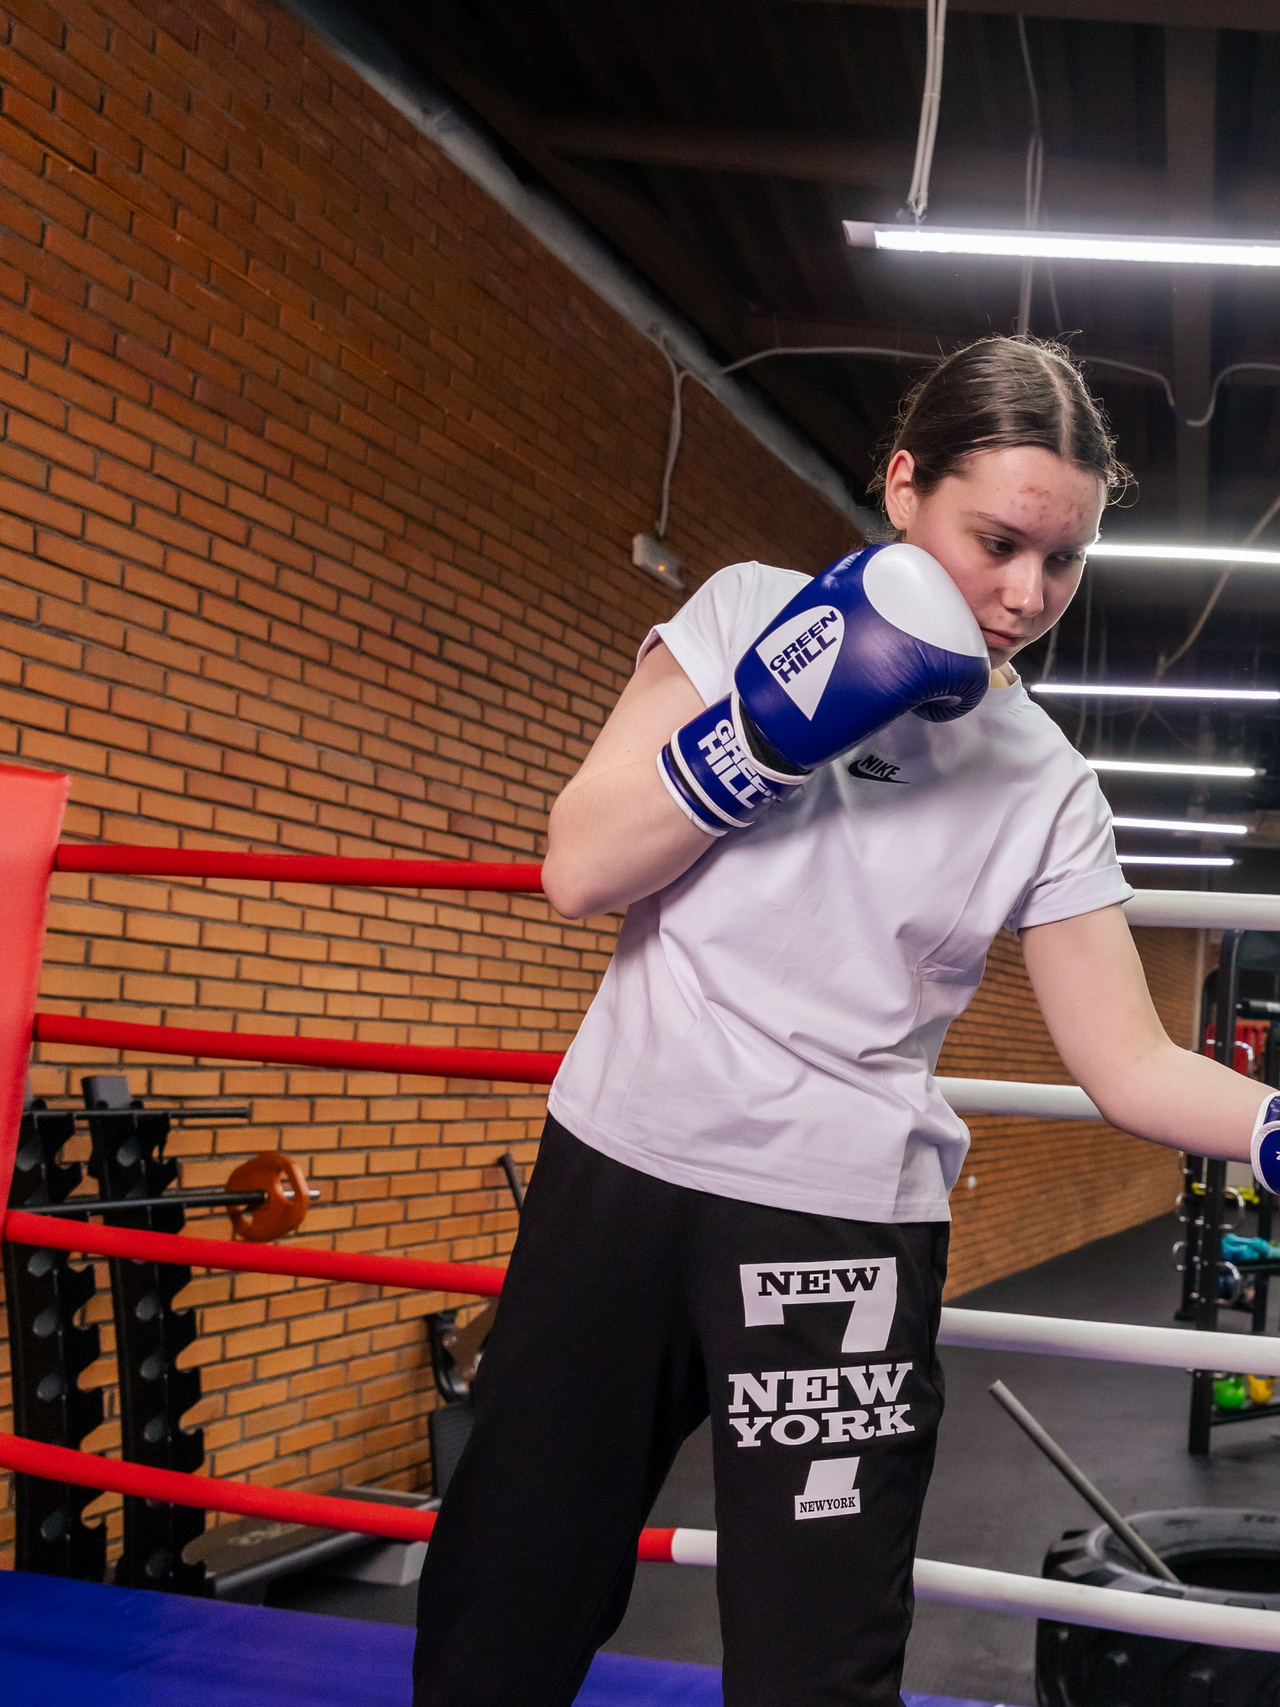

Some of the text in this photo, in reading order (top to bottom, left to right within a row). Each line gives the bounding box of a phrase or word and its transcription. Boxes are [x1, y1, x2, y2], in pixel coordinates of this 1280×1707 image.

[770, 609, 838, 671] GREEN
[777, 634, 837, 684] HILL
[697, 730, 756, 810] HILL
[860, 755, 901, 780] NIKE
[757, 1266, 881, 1297] NEW
[728, 1362, 913, 1413] NEW
[729, 1404, 915, 1447] YORK
